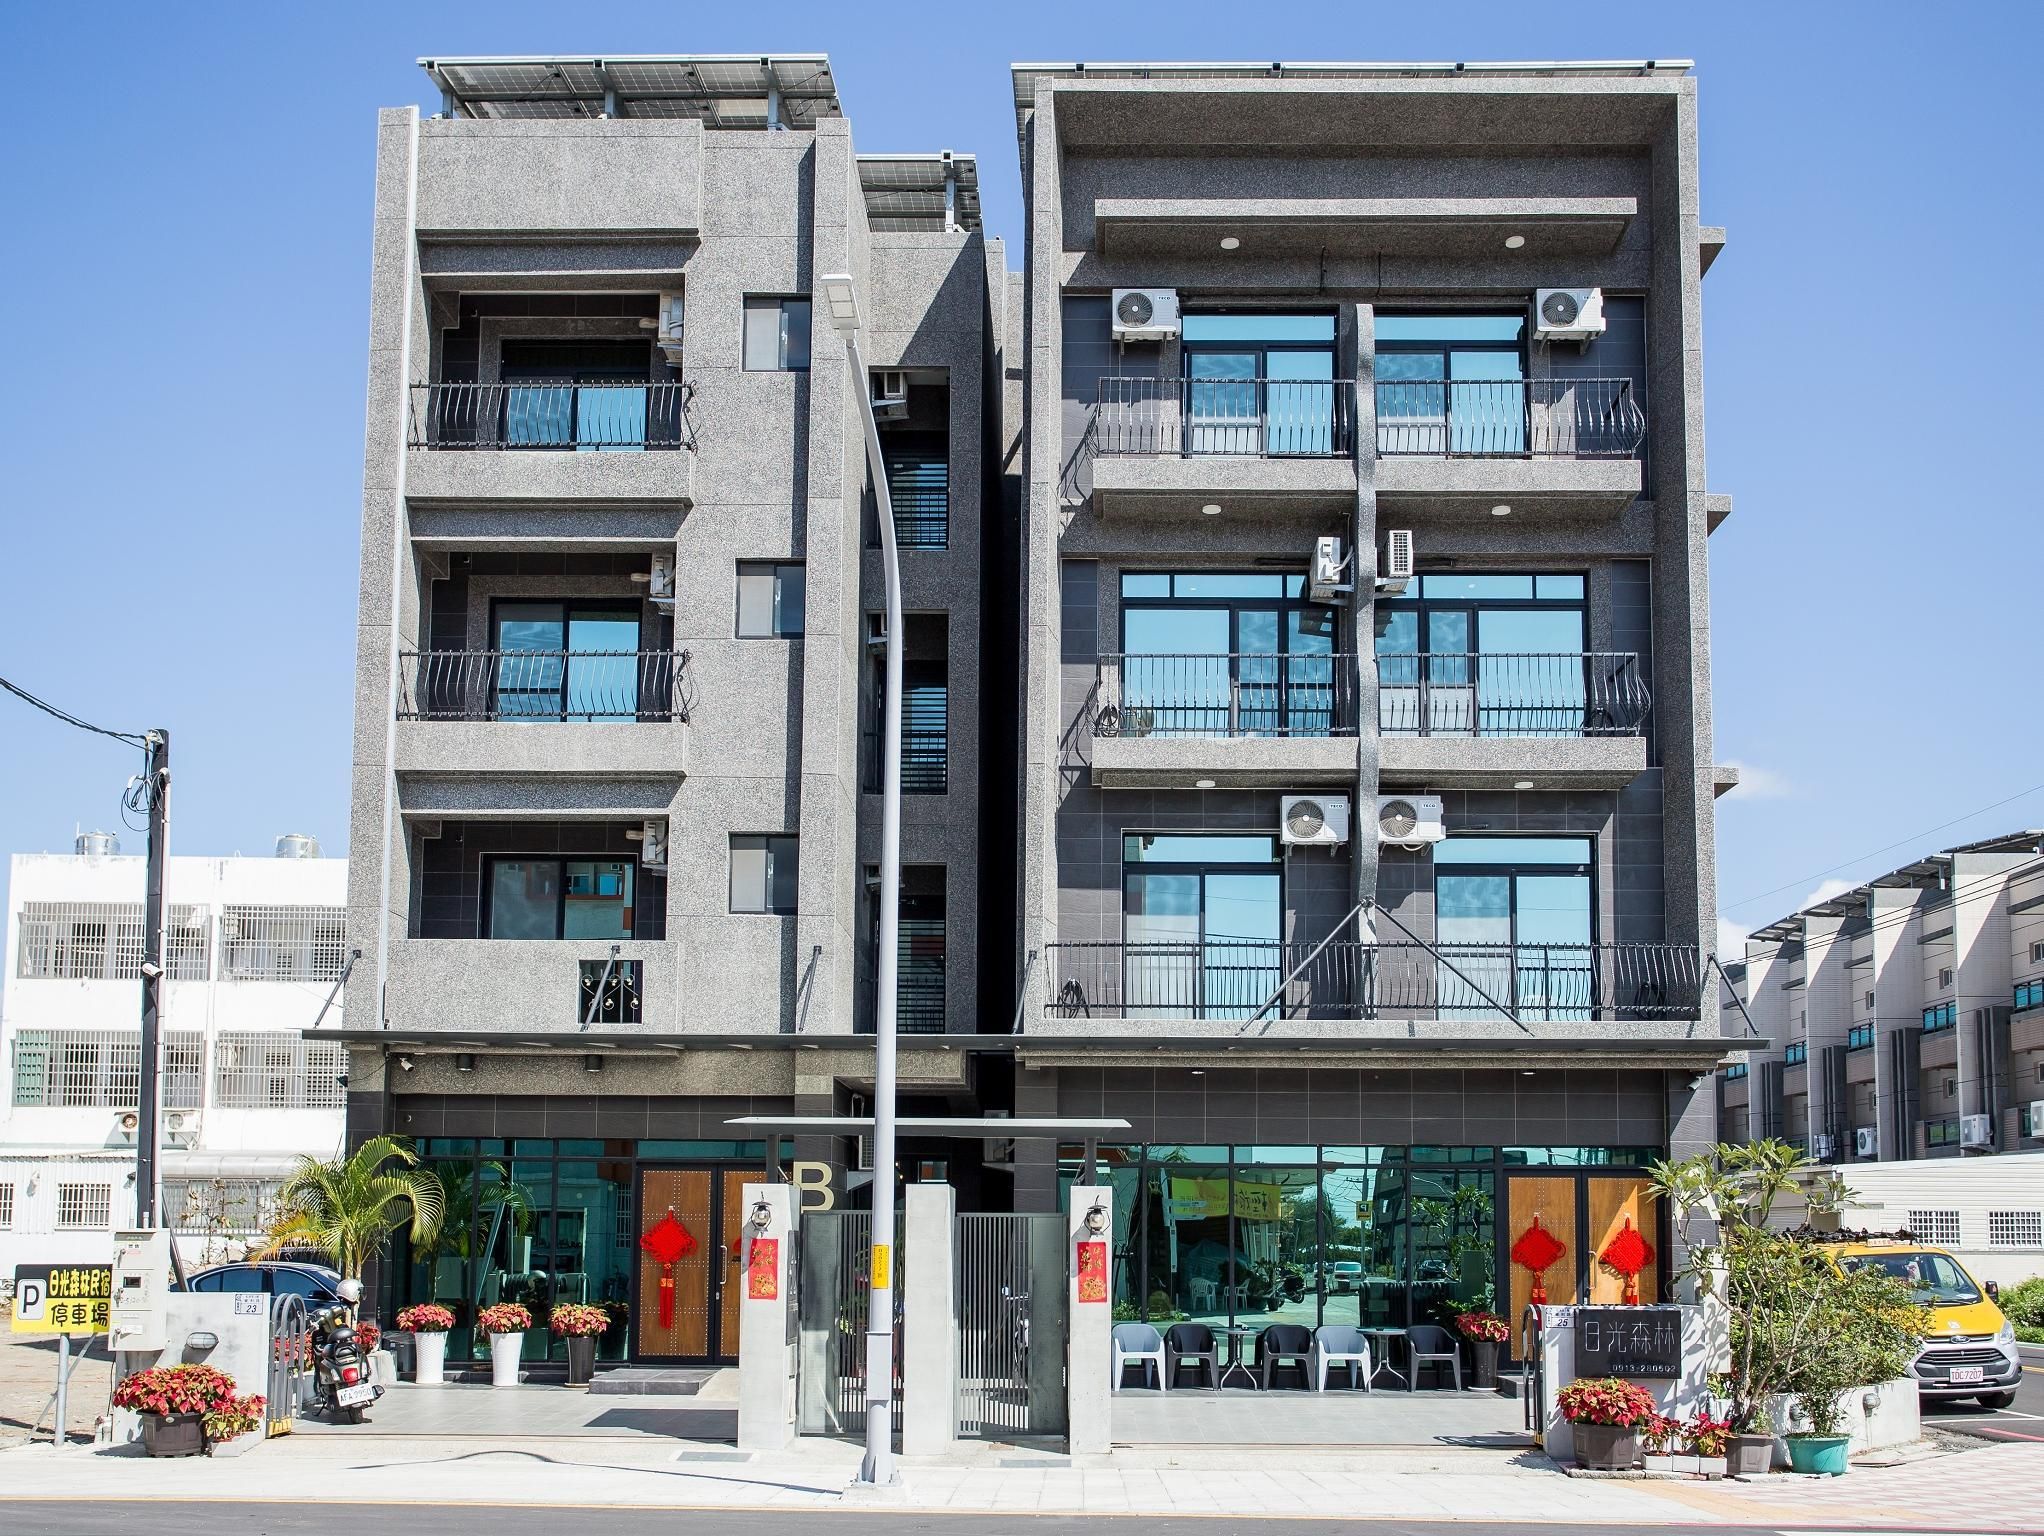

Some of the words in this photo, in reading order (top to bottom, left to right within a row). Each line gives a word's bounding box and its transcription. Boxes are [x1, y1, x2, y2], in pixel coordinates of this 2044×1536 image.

[793, 1161, 835, 1212] B
[49, 1268, 111, 1297] 日光森林民宿
[23, 1284, 40, 1314] P
[246, 1304, 257, 1312] 23
[51, 1302, 109, 1327] 停車場
[1557, 1318, 1568, 1326] 25
[1585, 1321, 1675, 1355] 日光森林
